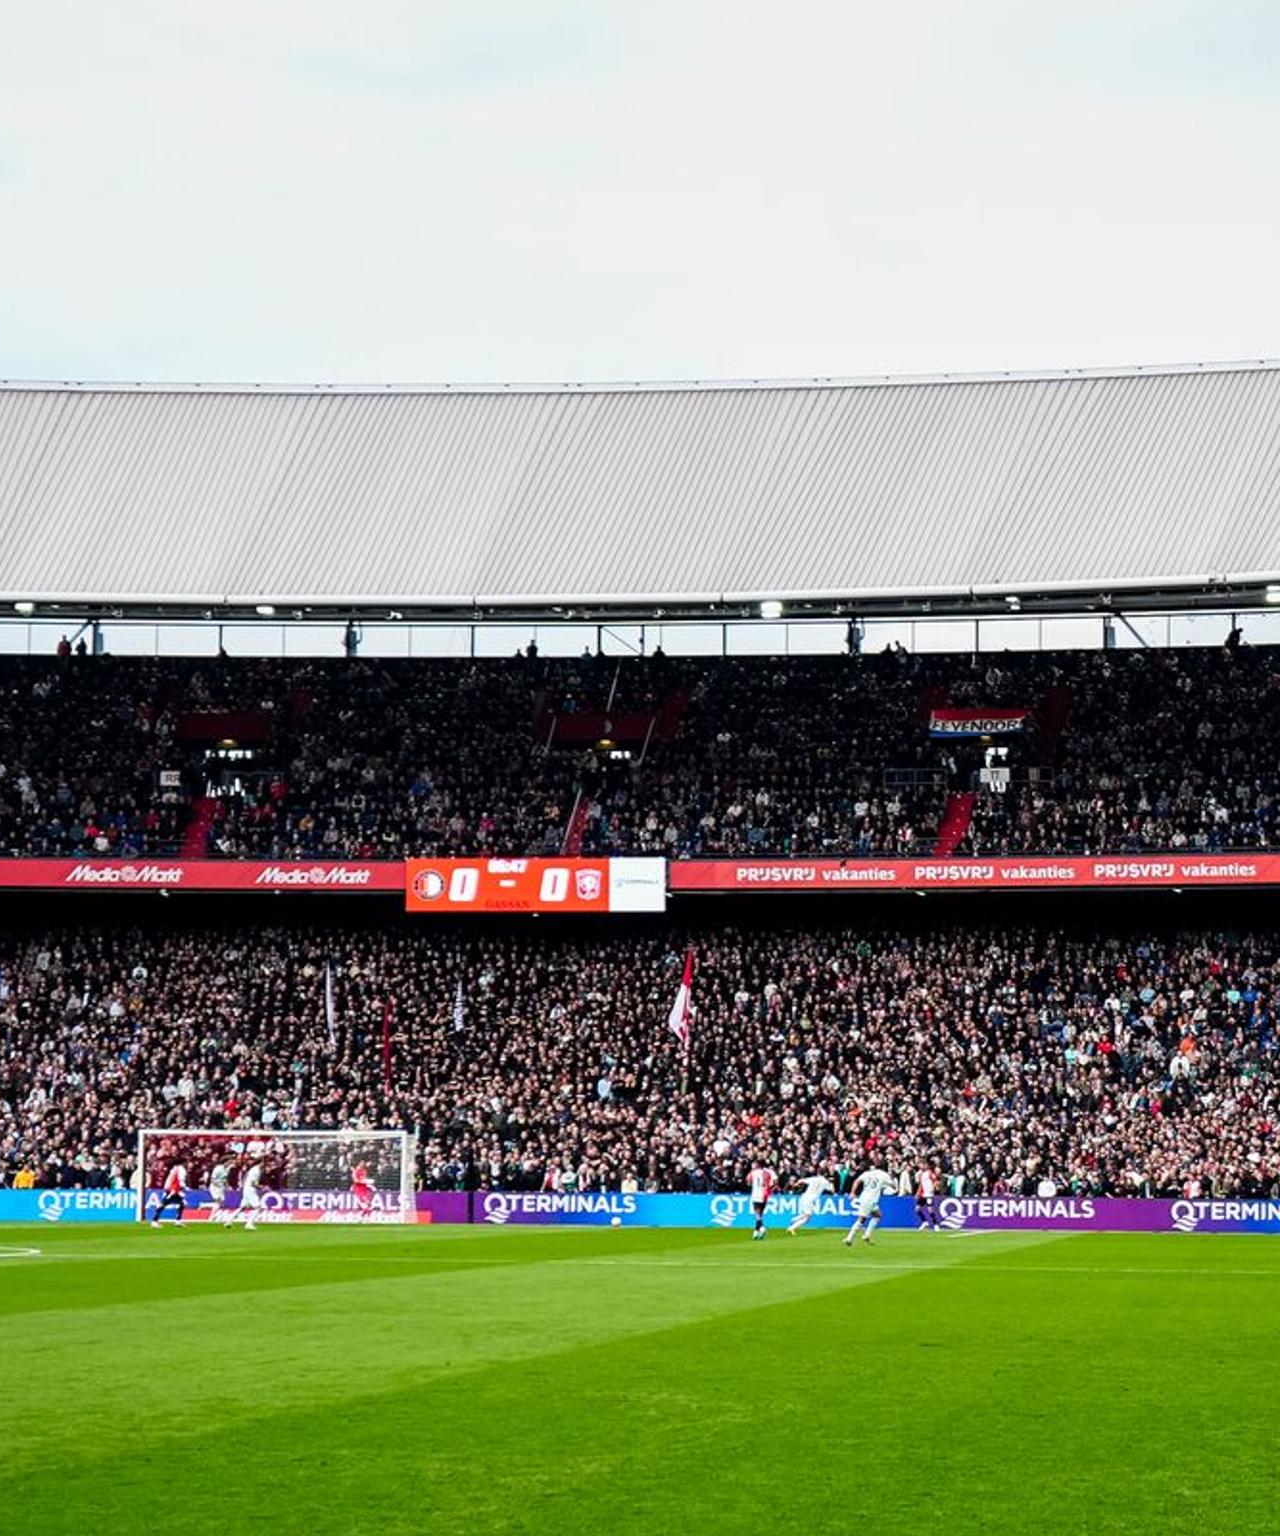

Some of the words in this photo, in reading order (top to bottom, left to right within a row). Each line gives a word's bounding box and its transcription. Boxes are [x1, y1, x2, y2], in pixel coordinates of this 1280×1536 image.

[931, 719, 1023, 732] FEYENOOR
[822, 867, 896, 881] vakanties
[1000, 865, 1075, 879] vakanties
[1181, 862, 1257, 877] vakanties
[448, 867, 479, 902] 0
[540, 867, 570, 902] 0
[484, 1193, 637, 1224] QTERMINALS
[939, 1197, 1095, 1229] QTERMINALS
